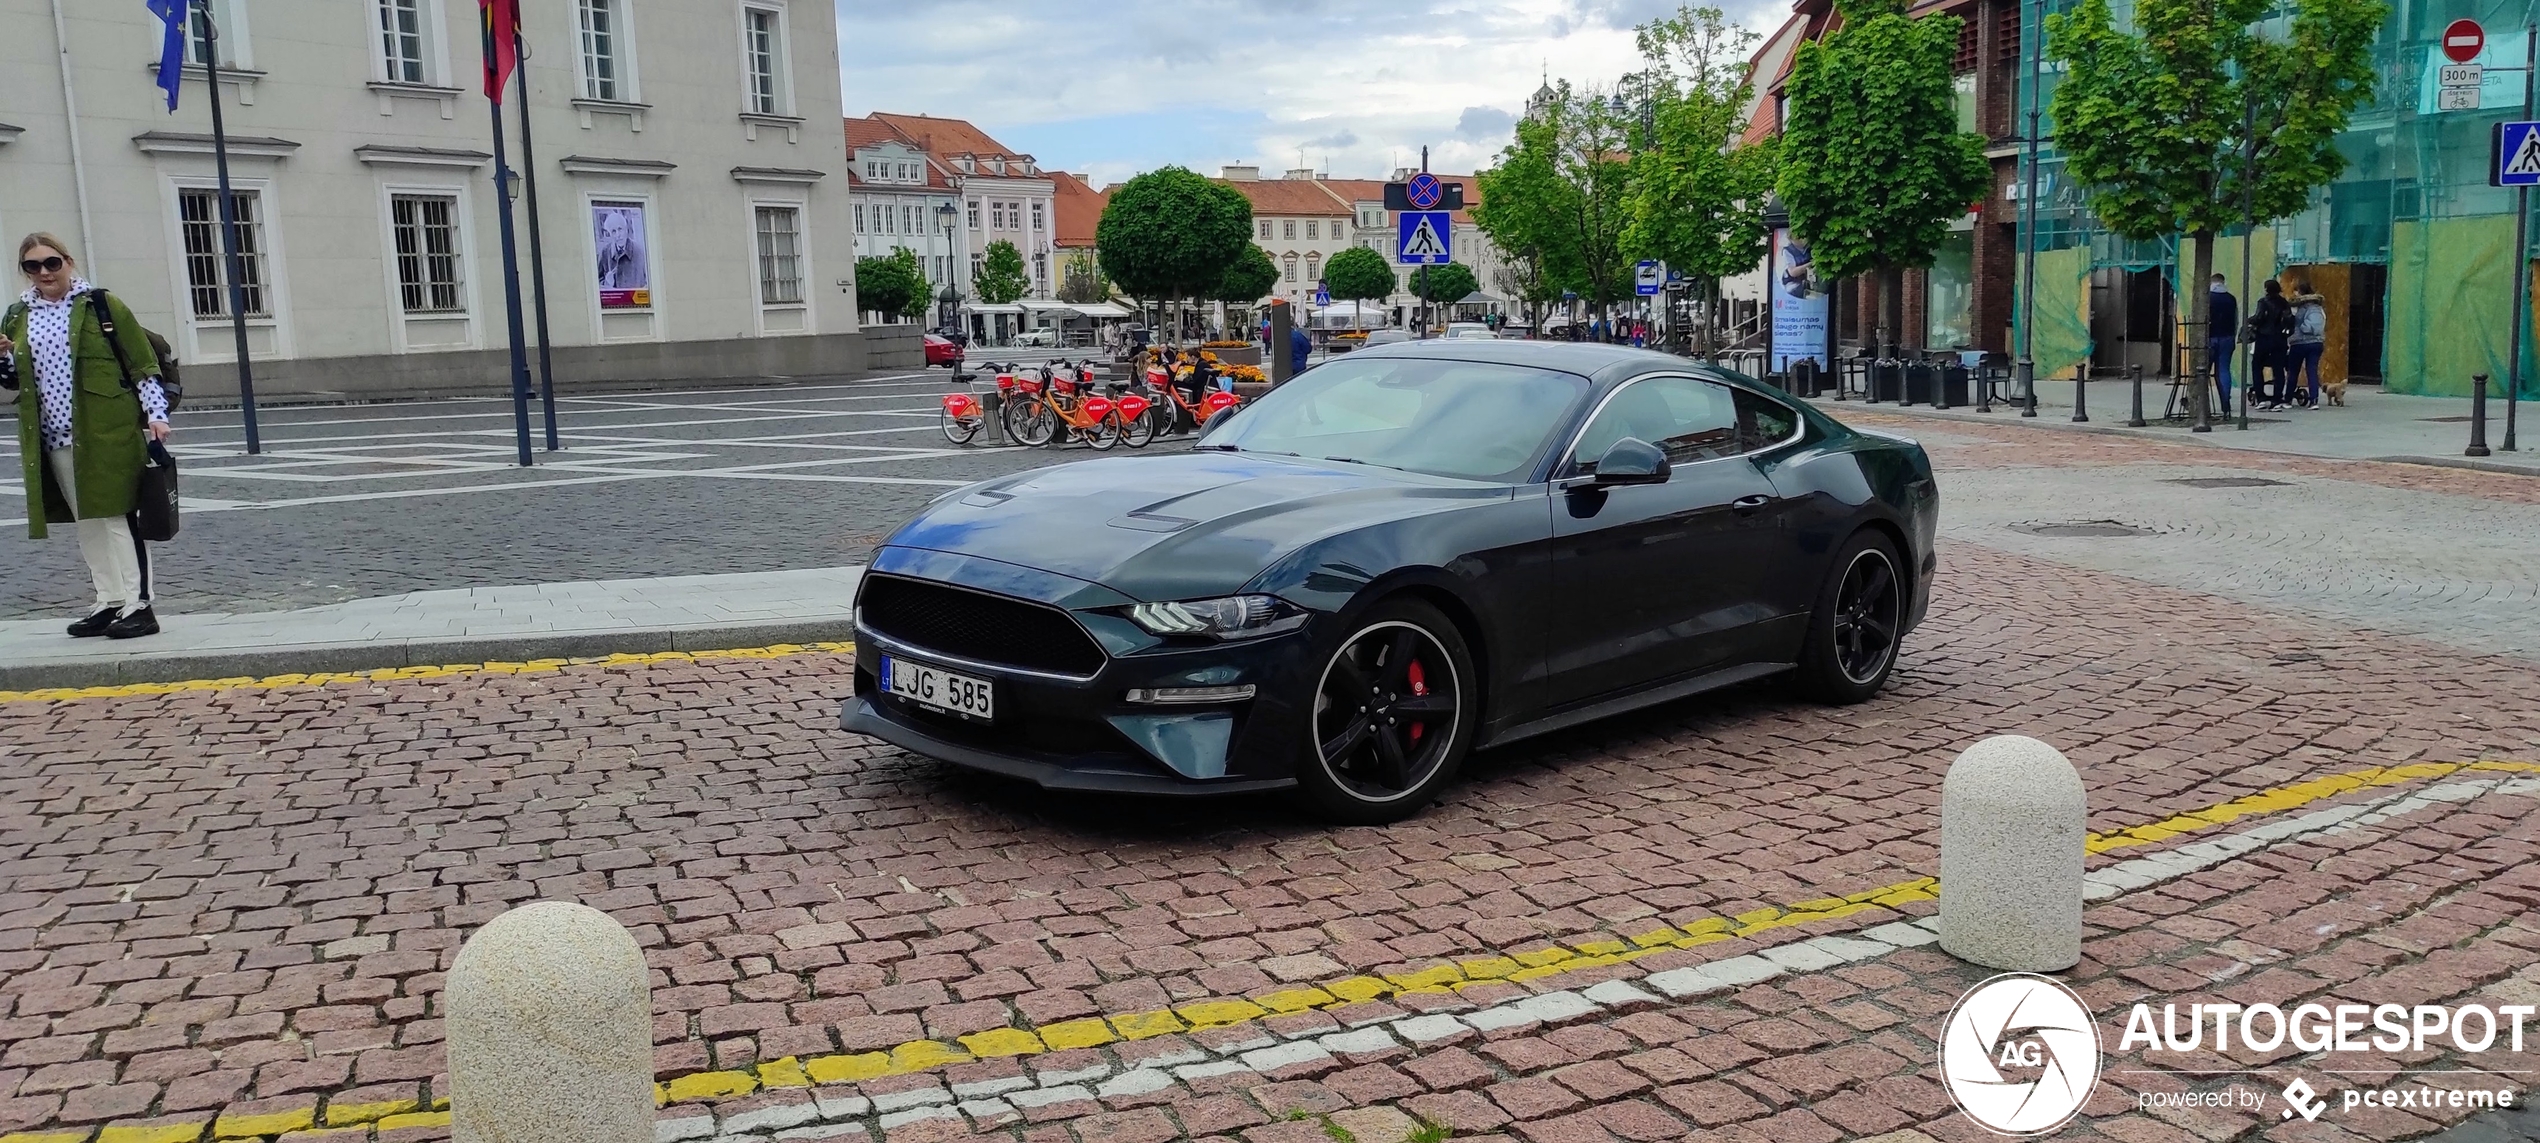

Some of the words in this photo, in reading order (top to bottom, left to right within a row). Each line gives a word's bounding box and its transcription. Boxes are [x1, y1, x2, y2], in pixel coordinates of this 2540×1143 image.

[2445, 70, 2466, 81] 300
[2469, 72, 2479, 80] m
[882, 676, 889, 685] LT
[892, 662, 934, 699] LJG
[949, 677, 988, 713] 585
